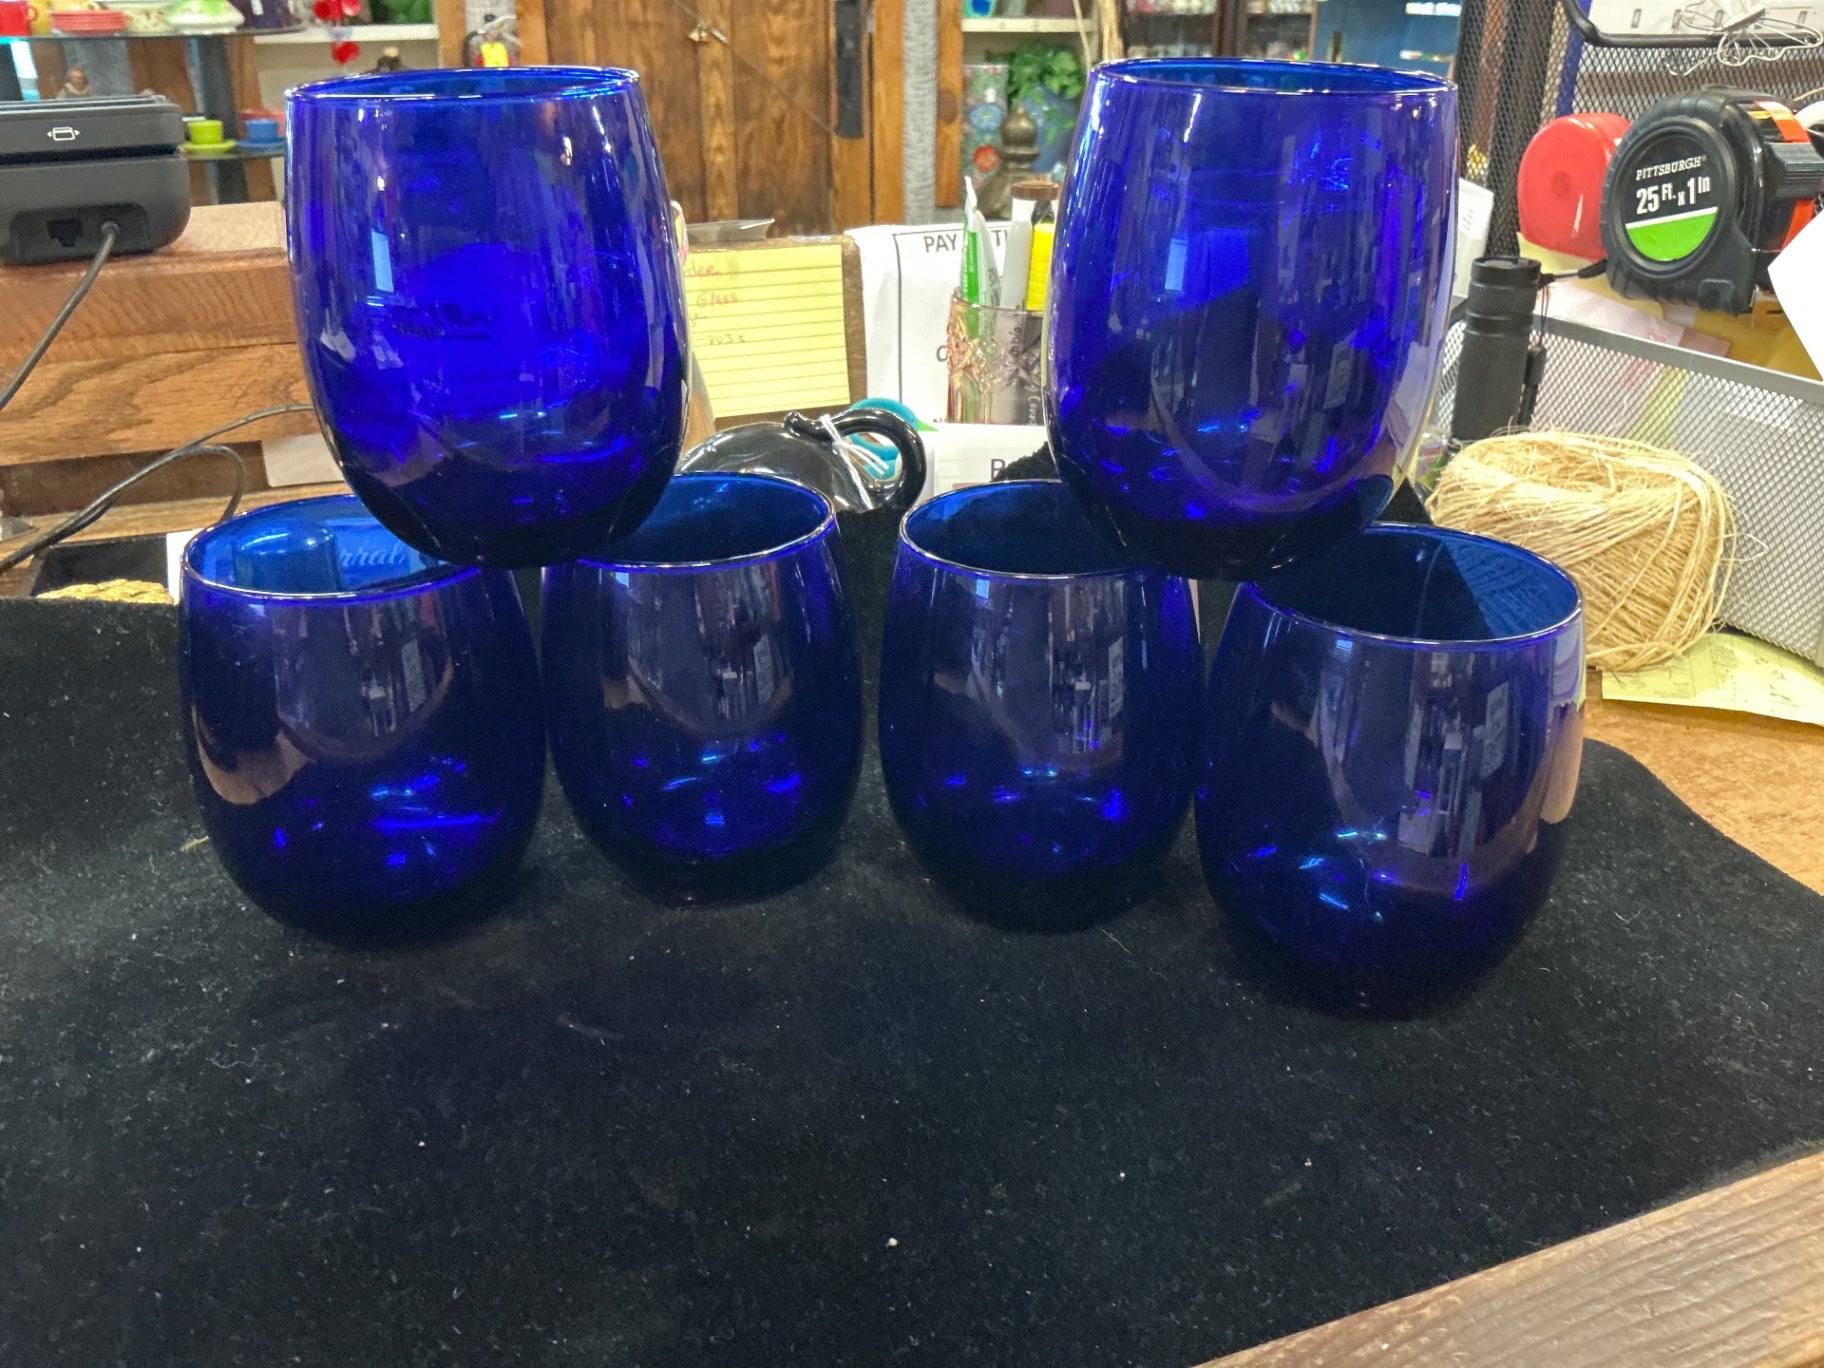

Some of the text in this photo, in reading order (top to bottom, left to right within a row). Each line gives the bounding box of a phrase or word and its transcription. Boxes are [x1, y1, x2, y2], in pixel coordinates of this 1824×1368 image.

[1635, 155, 1702, 181] PITTSBURGH
[1636, 185, 1660, 215] 25
[1661, 182, 1677, 201] Ft.
[923, 232, 957, 254] PAY
